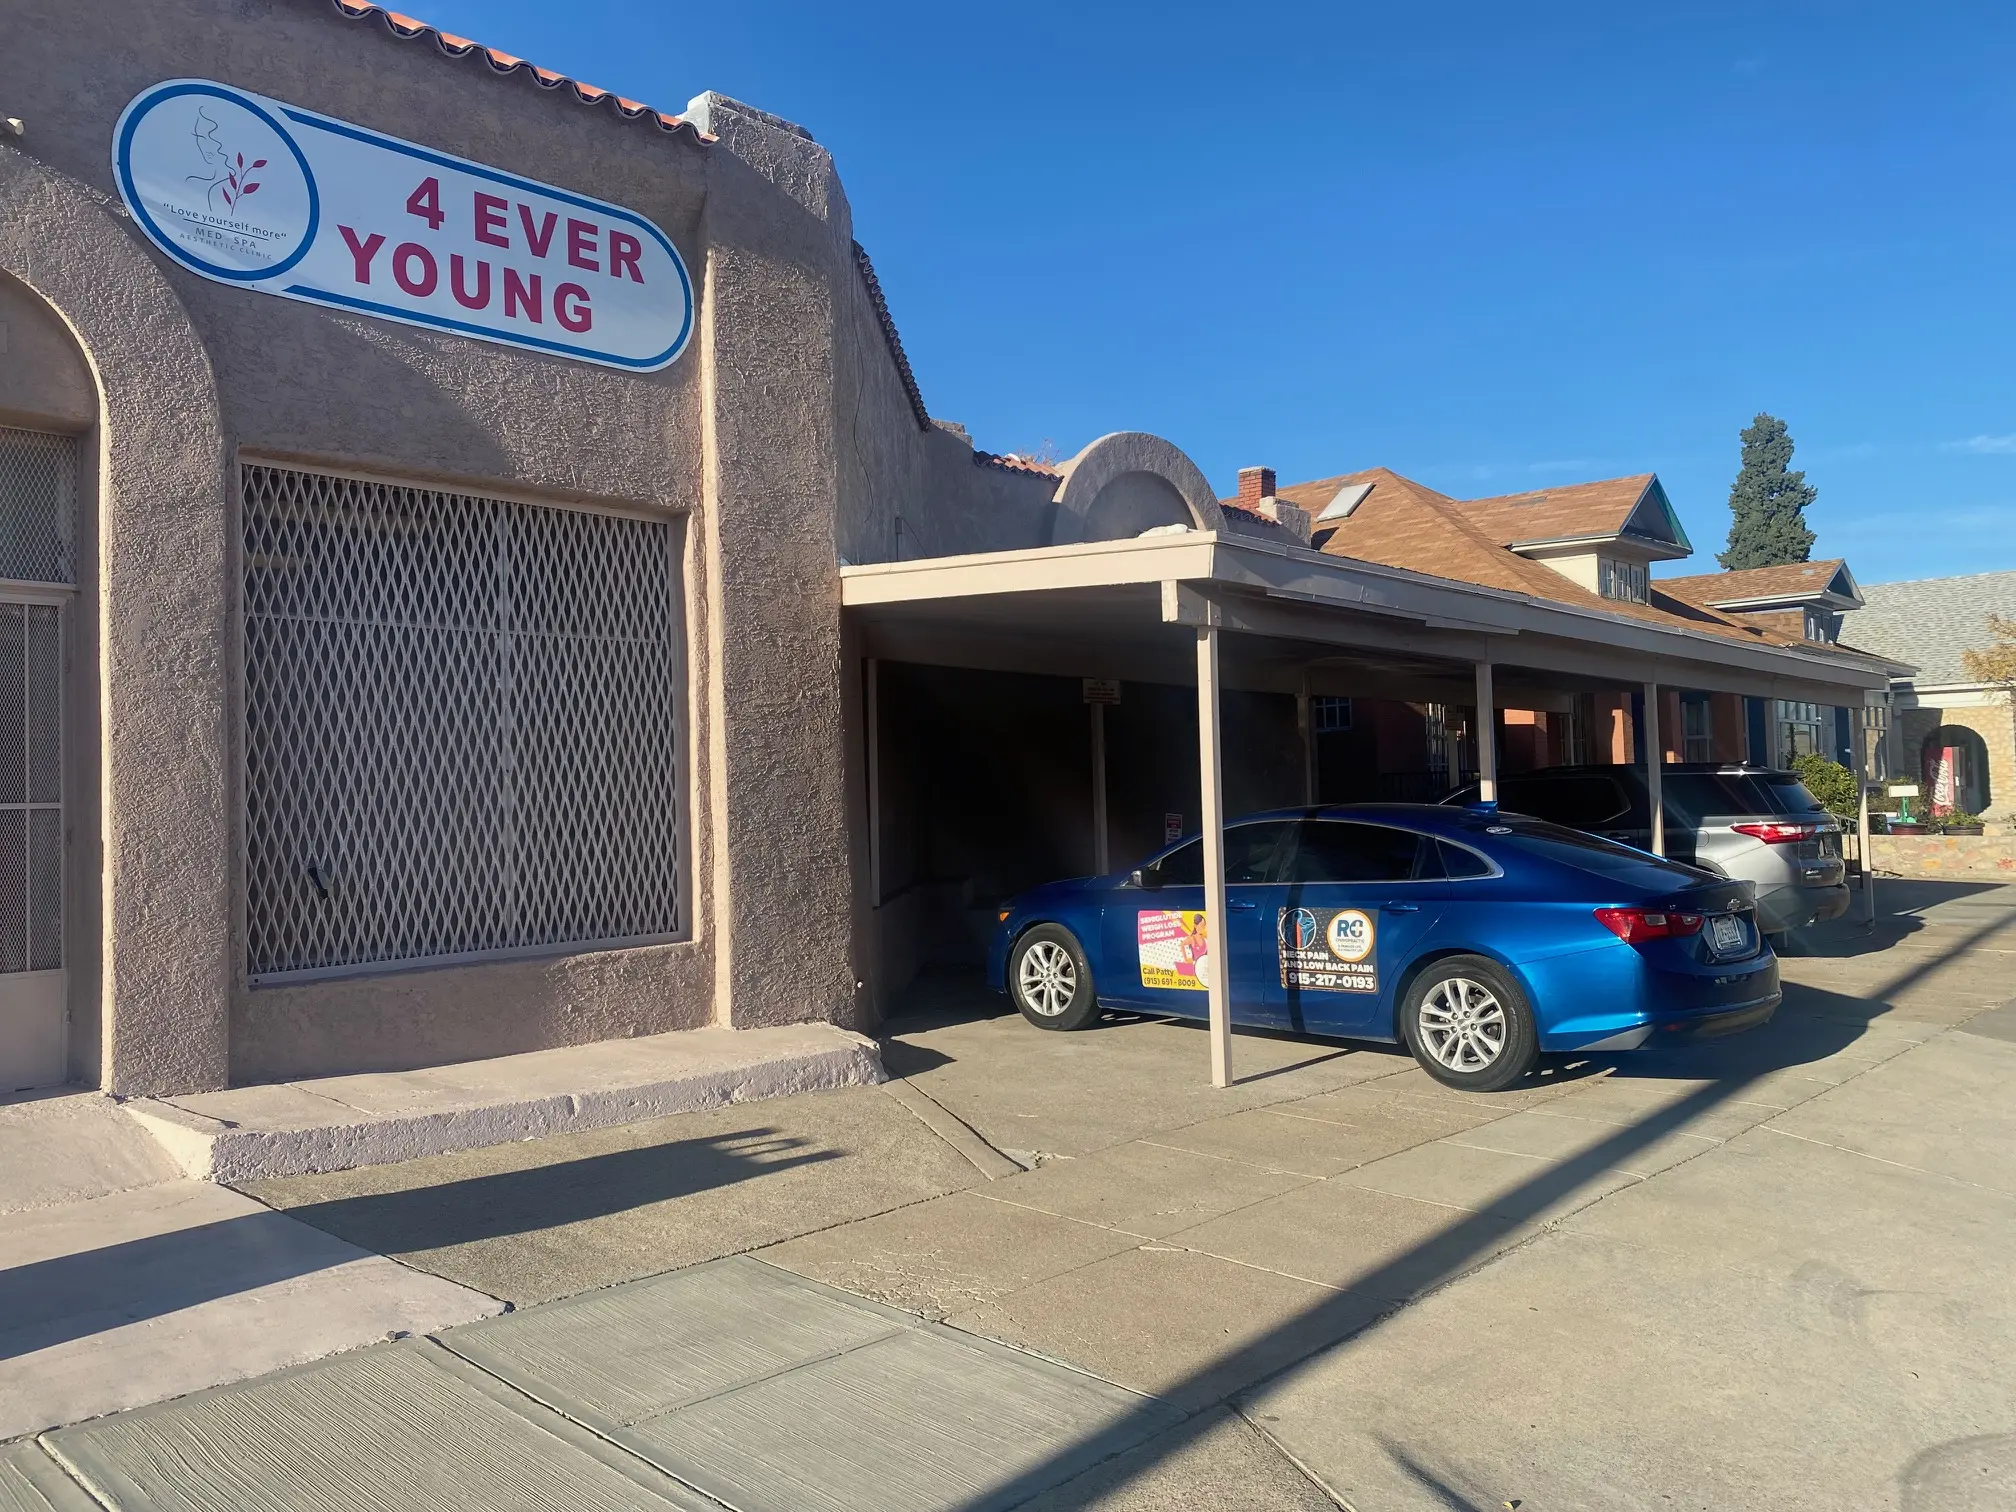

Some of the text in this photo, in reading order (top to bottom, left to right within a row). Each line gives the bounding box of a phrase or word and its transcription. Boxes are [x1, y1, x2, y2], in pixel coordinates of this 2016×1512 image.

[202, 214, 250, 231] yourself
[409, 178, 642, 282] 4 EVER
[180, 233, 272, 260] AESTHETIC CLINIC
[195, 227, 256, 249] MED SPA
[343, 228, 591, 332] YOUNG
[1142, 930, 1175, 941] PROGRAM
[1282, 950, 1329, 960] NECK PAIN
[1143, 967, 1174, 977] Call Patty
[1284, 959, 1374, 973] AND LOW BACK PAIN
[1144, 977, 1160, 986] (915)
[1289, 972, 1374, 989] 915-217-0193
